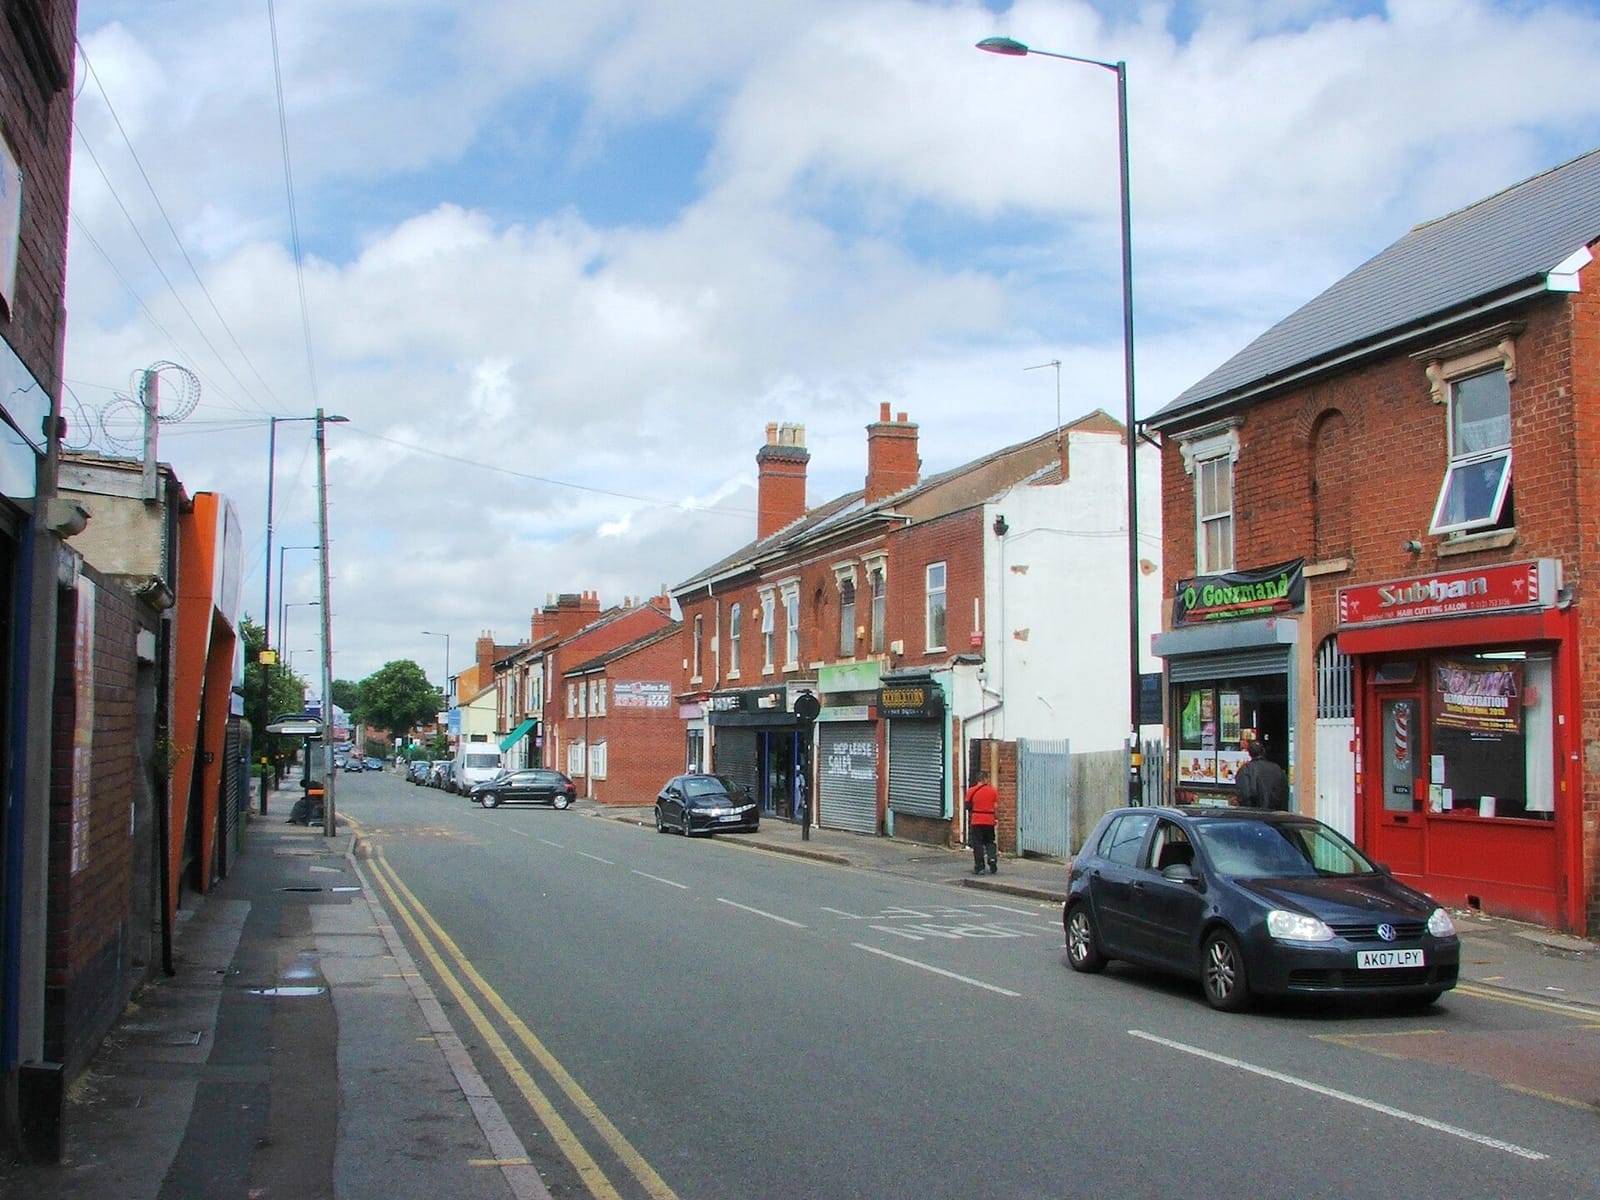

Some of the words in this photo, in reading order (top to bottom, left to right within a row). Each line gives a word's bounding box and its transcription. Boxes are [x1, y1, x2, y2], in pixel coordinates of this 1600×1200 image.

[1202, 573, 1289, 607] Gourmand
[1378, 576, 1488, 608] Subhan
[1396, 608, 1413, 618] HAIR
[1414, 604, 1443, 616] CUTTING
[1444, 601, 1467, 613] SALON
[1443, 692, 1508, 708] DEMONSTRATION
[1364, 953, 1394, 966] AK07
[1397, 952, 1419, 965] LPY
